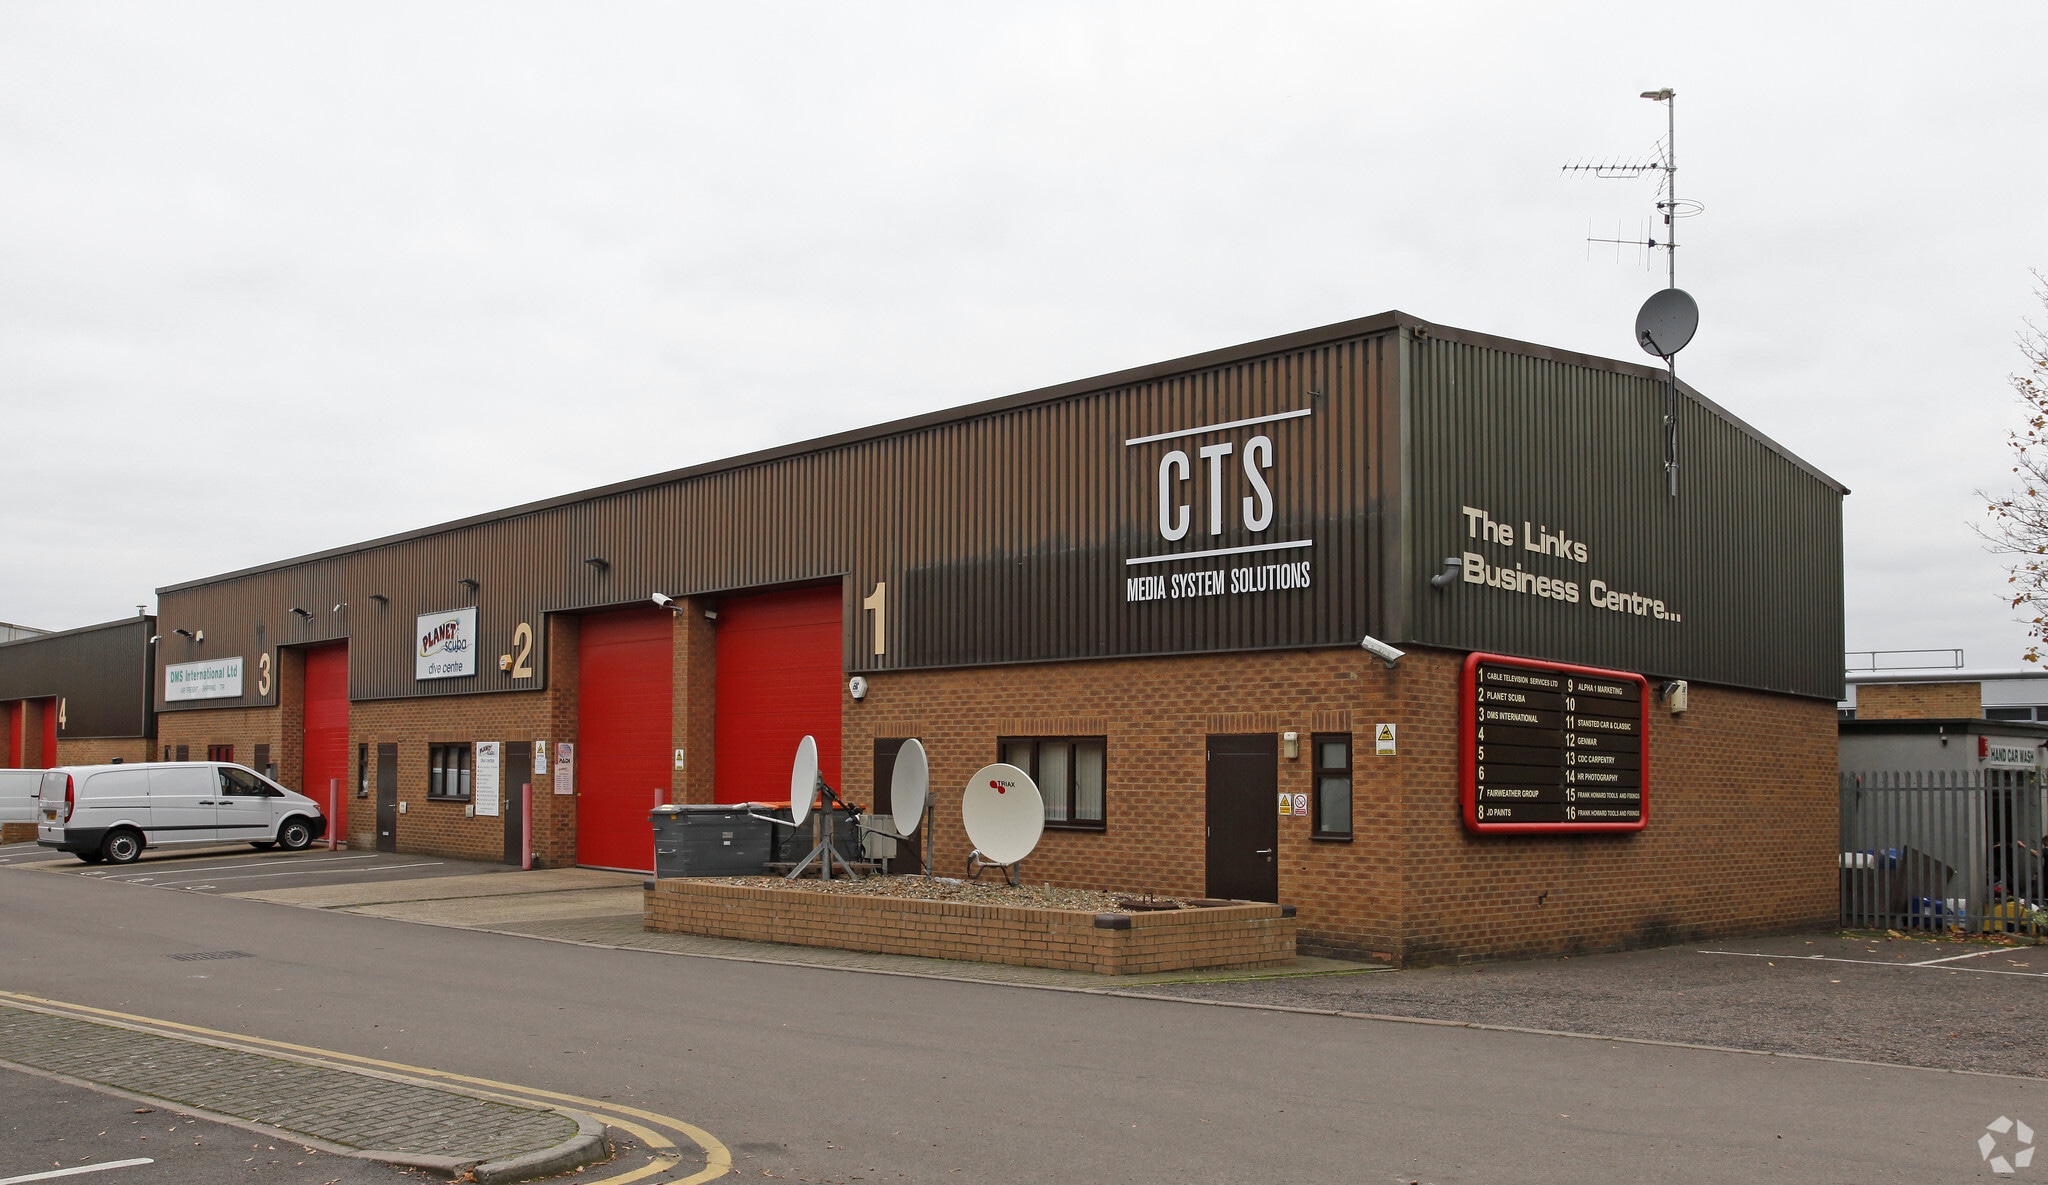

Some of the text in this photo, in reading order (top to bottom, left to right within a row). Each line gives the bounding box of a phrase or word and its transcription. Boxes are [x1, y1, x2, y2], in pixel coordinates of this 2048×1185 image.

[1158, 435, 1274, 542] CTS
[1462, 505, 1588, 563] The Links
[1127, 560, 1311, 602] MEDIA SYSTEM SOLUTIONS
[1463, 551, 1580, 603] Business
[864, 581, 886, 655] 1
[422, 623, 458, 653] PLANET
[444, 635, 467, 653] scuba
[512, 622, 533, 679] 2
[170, 664, 238, 683] DMS International Ltd
[258, 652, 271, 696] 3
[428, 661, 463, 675] dive centre
[1478, 668, 1483, 682] 1
[1486, 672, 1503, 681] CABLE
[1503, 674, 1529, 684] TELEVISION
[1530, 677, 1550, 687] SERVICES
[1478, 687, 1526, 703] 2 PLANET SCUBA
[1567, 679, 1573, 692] 9
[1577, 683, 1594, 692] ALPHA
[1597, 685, 1623, 695] MARKETING
[1565, 697, 1575, 711] 10
[58, 697, 67, 730] 4
[1478, 707, 1539, 723] 3 DMS INTERNATIONAL
[1565, 715, 1574, 729] 11
[1577, 719, 1600, 728] STANSTED
[1600, 721, 1610, 729] CAR
[1613, 722, 1631, 731] CLASSIC
[1478, 726, 1484, 741] 4
[1565, 733, 1575, 747] 12
[1478, 746, 1484, 760] 5
[1565, 751, 1576, 765] 13
[1588, 755, 1615, 764] CARPENTRY
[1991, 748, 2006, 762] HAND
[2008, 748, 2018, 762] CAR
[2020, 749, 2035, 763] WASH
[1478, 765, 1485, 780] 6
[1565, 769, 1618, 783] 14 HR PHOTOGRAPHY
[997, 780, 1015, 788] TRIAX
[1478, 786, 1539, 800] 7 FAIRWEATHER GROUP
[1565, 787, 1576, 801] 15
[1478, 805, 1511, 820] 8 JD PAINTS
[1565, 806, 1576, 820] 16
